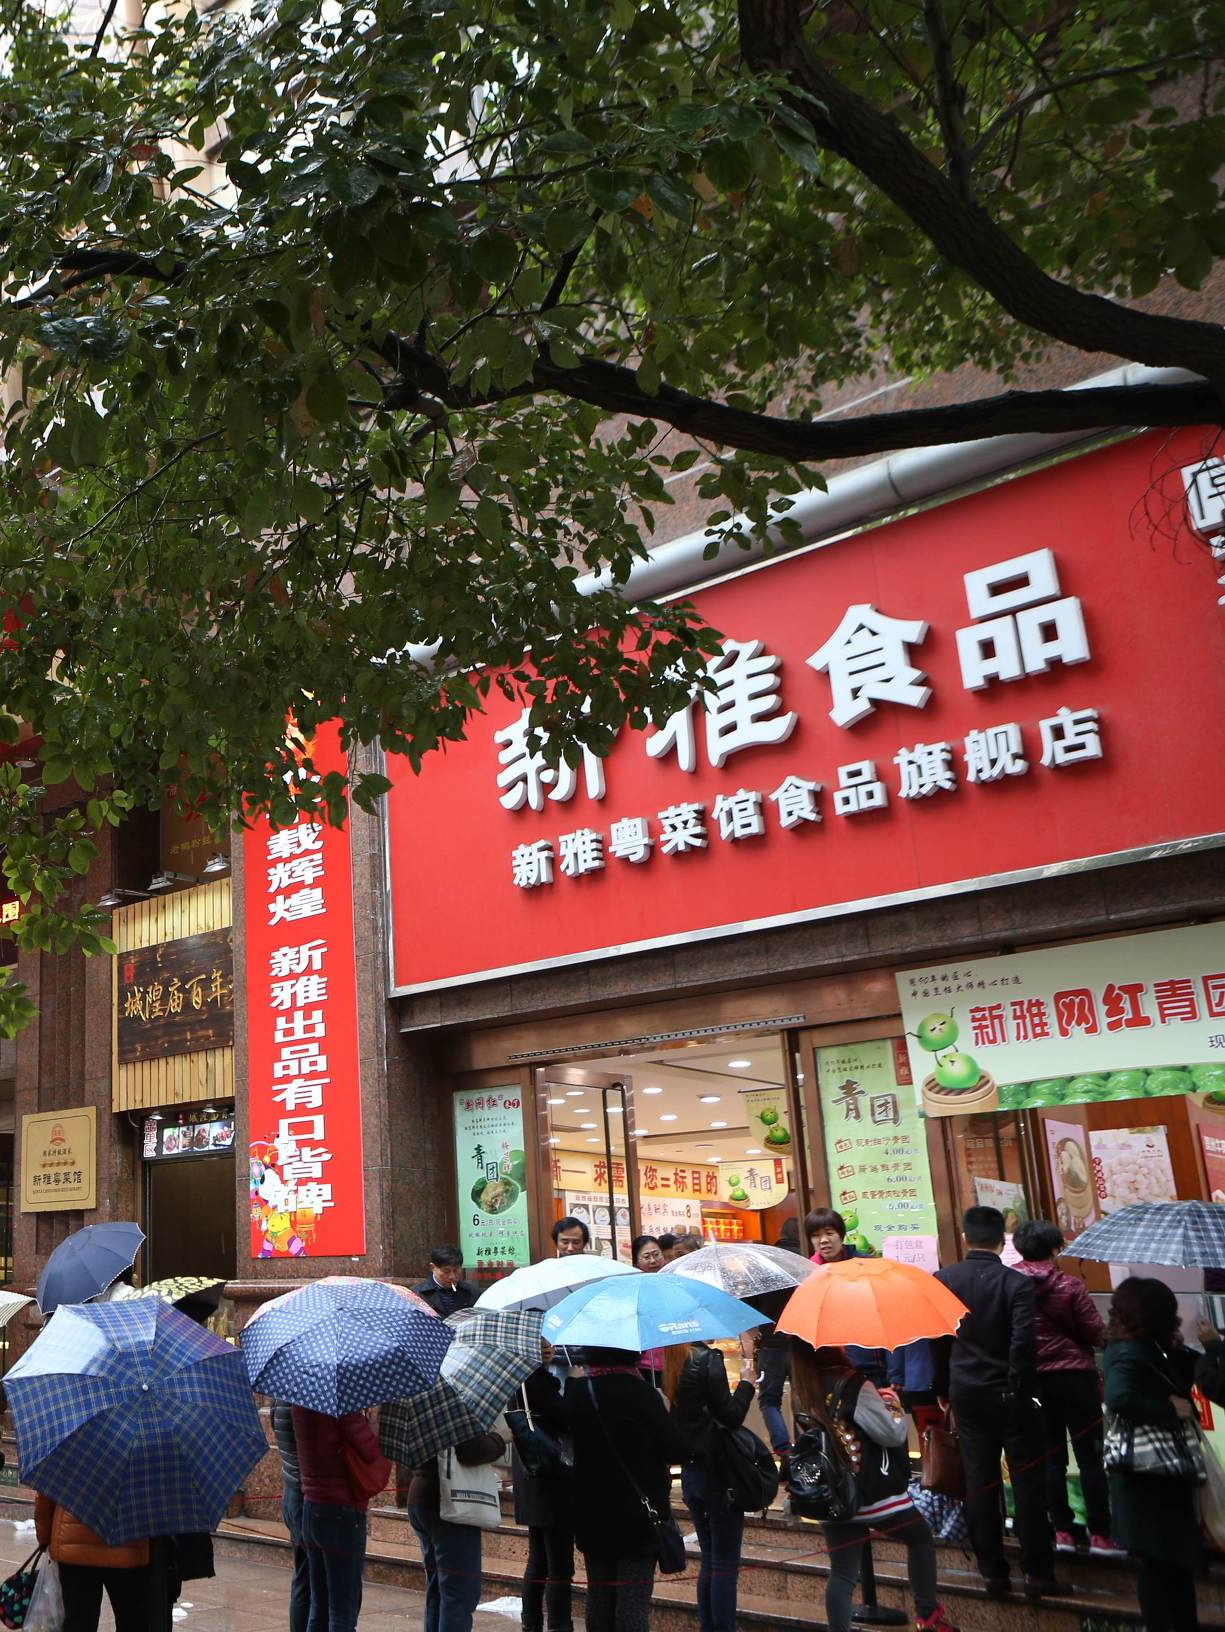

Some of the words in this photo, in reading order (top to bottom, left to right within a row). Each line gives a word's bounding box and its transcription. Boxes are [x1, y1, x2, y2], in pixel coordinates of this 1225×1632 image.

[512, 706, 1104, 889] 新雅粤菜馆食品旗舰店
[265, 795, 327, 927] 载辉煌
[124, 968, 234, 1021] 城隍庙百年
[269, 938, 335, 1215] 新雅出品有口皆碑
[832, 1079, 902, 1126] 青团
[33, 1170, 83, 1186] 新雅粤菜馆
[472, 1143, 501, 1183] 青团
